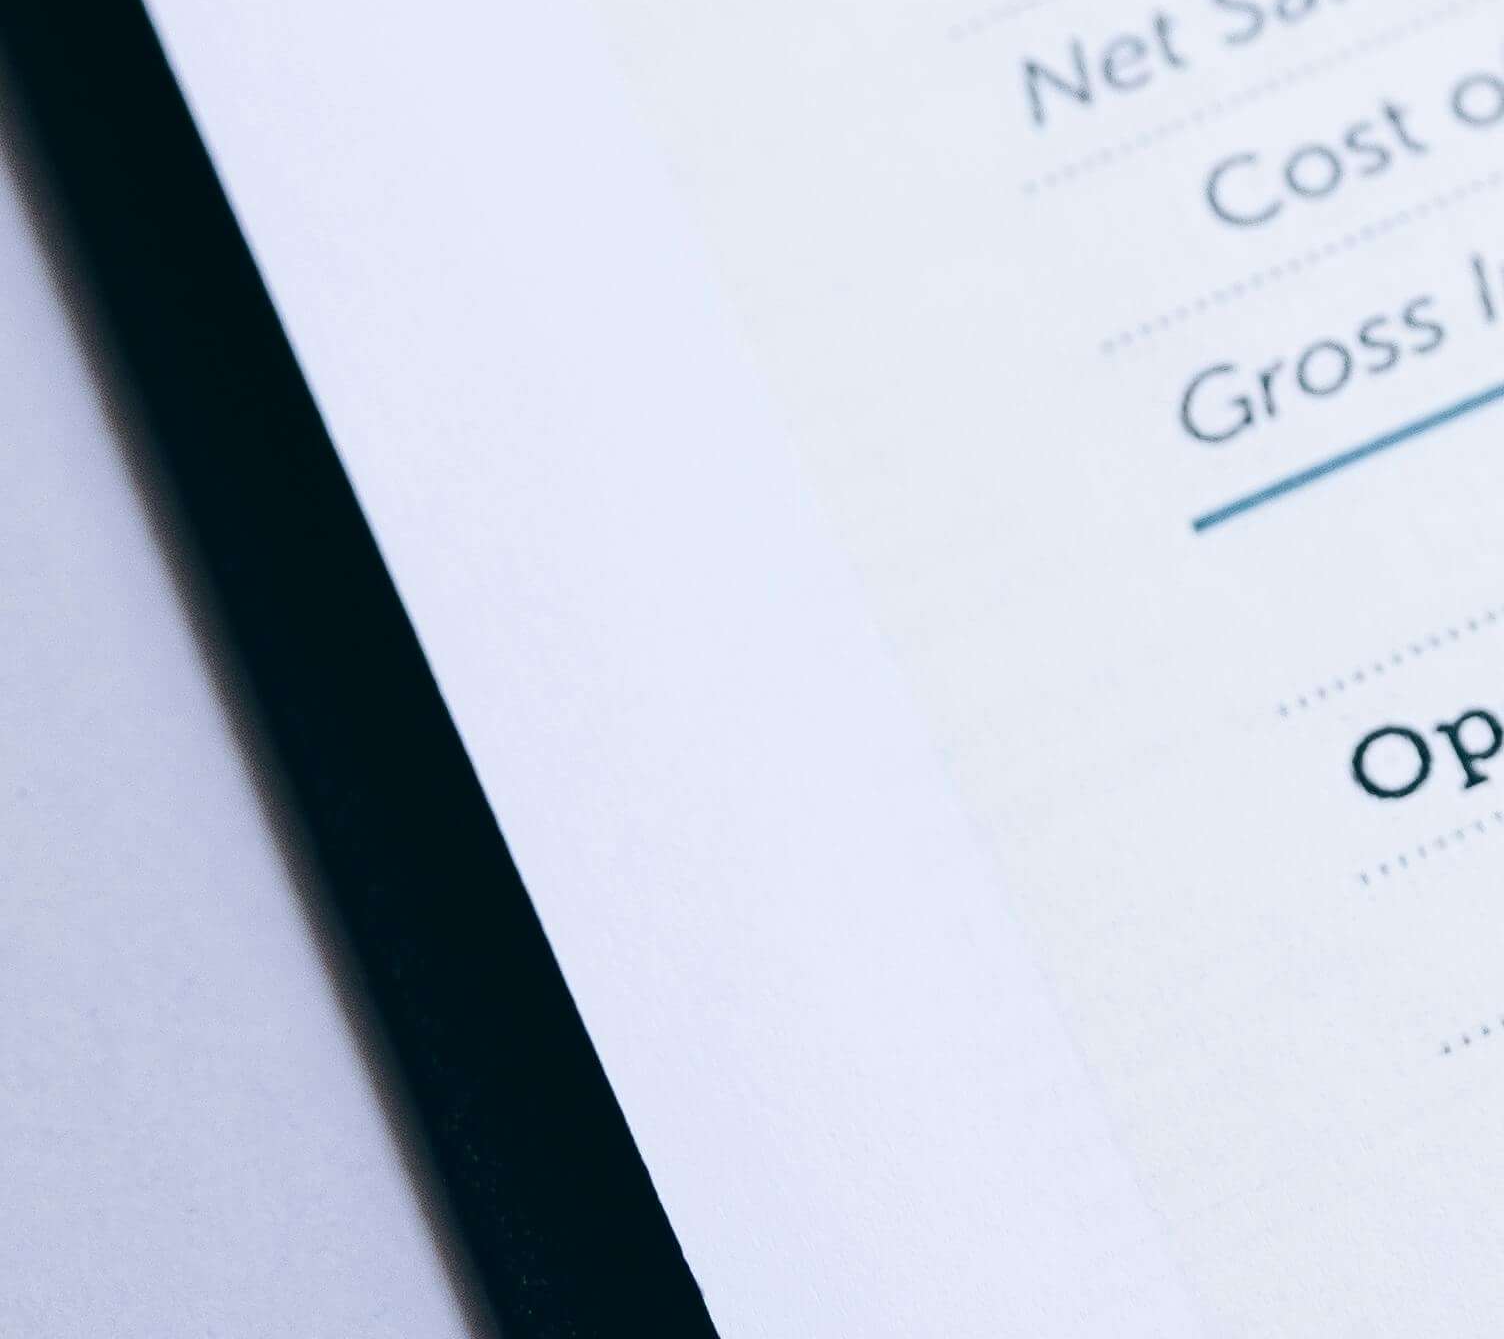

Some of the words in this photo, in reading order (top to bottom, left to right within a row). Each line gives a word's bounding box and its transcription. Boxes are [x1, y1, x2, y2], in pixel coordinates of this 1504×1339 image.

[1019, 9, 1189, 130] Net
[1200, 98, 1431, 232] Cost
[1175, 294, 1449, 448] Gross
